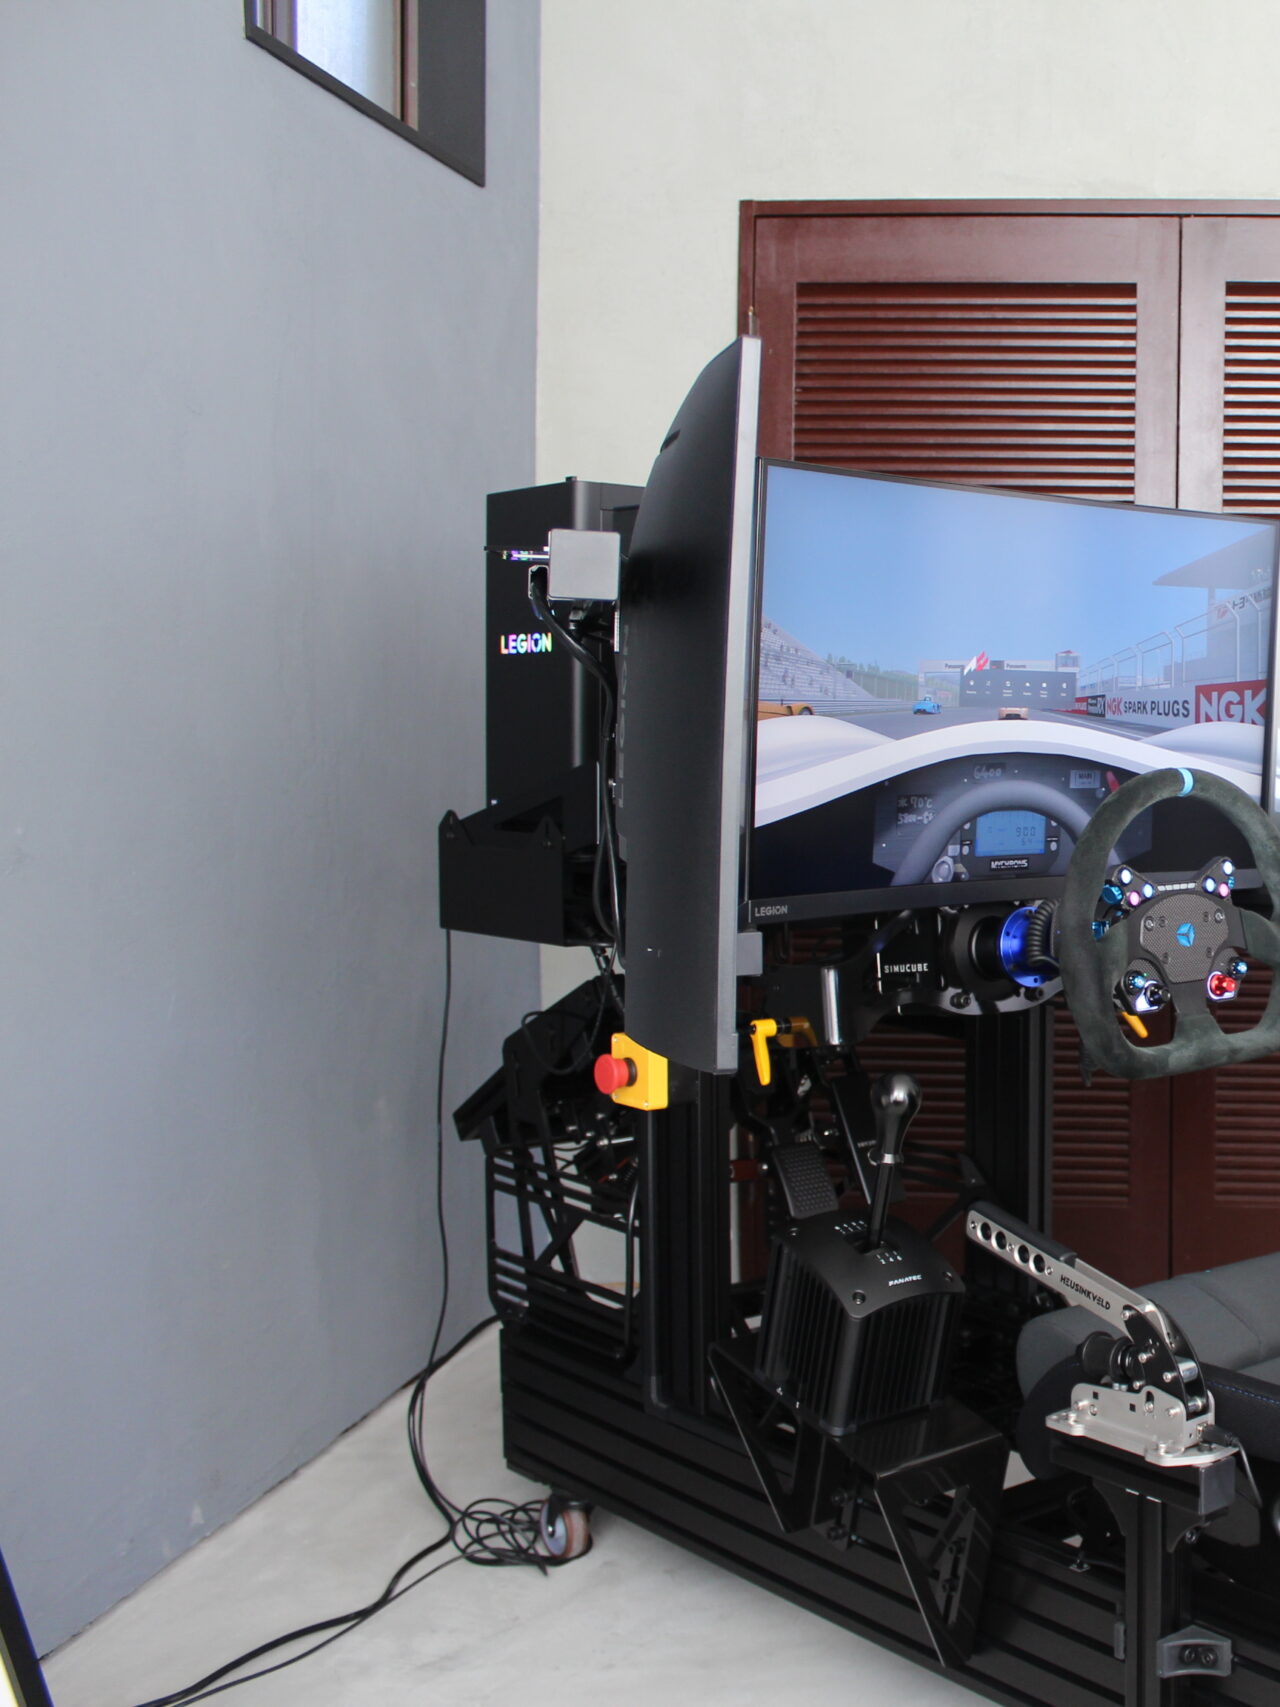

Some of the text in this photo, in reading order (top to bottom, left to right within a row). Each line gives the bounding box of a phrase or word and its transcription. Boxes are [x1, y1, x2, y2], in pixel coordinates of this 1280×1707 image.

[500, 632, 552, 654] LEGION
[1107, 700, 1190, 718] NGK SPARK PLUGS
[1200, 687, 1267, 727] NGK
[755, 905, 788, 916] LEGION
[884, 963, 928, 973] SIMUCUBE
[888, 1275, 922, 1286] FANATEC
[1060, 1274, 1111, 1310] HEUSINKVELD
